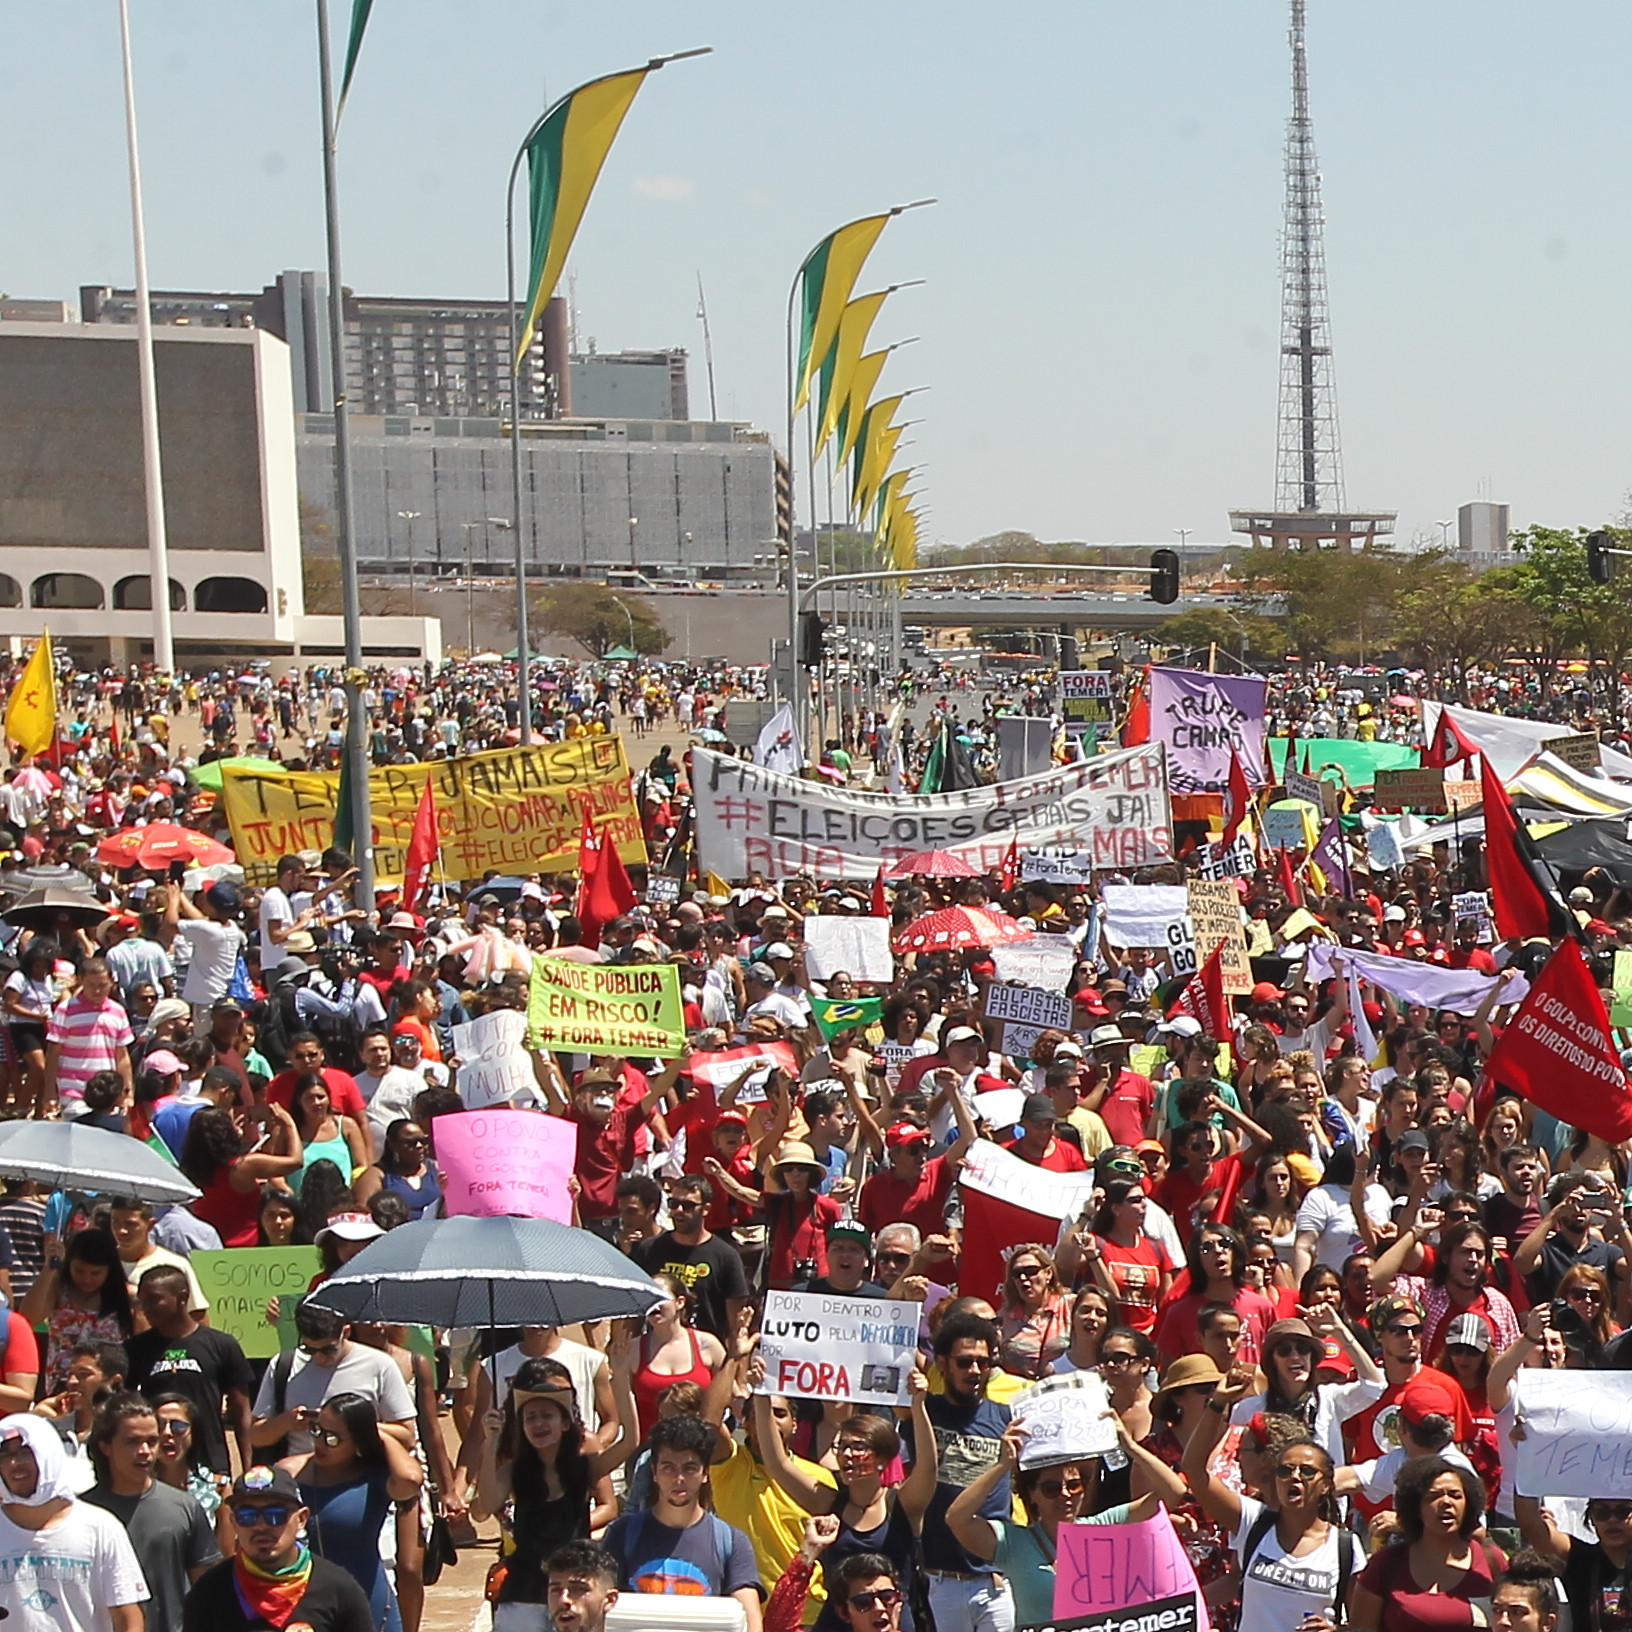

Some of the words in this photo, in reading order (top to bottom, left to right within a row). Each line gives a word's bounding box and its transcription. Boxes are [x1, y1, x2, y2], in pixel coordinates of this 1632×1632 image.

[1062, 675, 1108, 688] FORA
[1063, 688, 1109, 697] TEMER!
[1164, 692, 1249, 732] TRUPE
[1073, 755, 1163, 793] TEMER
[983, 793, 1091, 833] GERAIS
[1092, 826, 1171, 868] MAIS
[1202, 854, 1258, 881] TEMER
[539, 962, 589, 992] SAÚDE
[594, 966, 662, 994] PÚBLICA
[549, 997, 578, 1022] EM
[584, 1000, 663, 1025] RISCO!
[990, 984, 1071, 1013] GOLPISTAS
[988, 1001, 1069, 1027] FASCISTAS
[560, 1025, 602, 1044] FORA
[607, 1029, 669, 1049] TEMER
[472, 1145, 543, 1160] CONTRA
[468, 1180, 502, 1196] FORA
[212, 1259, 307, 1288] SOMOS
[659, 1262, 698, 1277] STAR
[216, 1297, 266, 1315] MAIS
[772, 1294, 802, 1313] POR
[821, 1300, 885, 1318] DENTRO
[763, 1320, 821, 1344] LUTO
[828, 1326, 858, 1342] PELA
[760, 1343, 784, 1358] POR
[777, 1358, 852, 1397] FORA
[1253, 1560, 1305, 1591] DREAM
